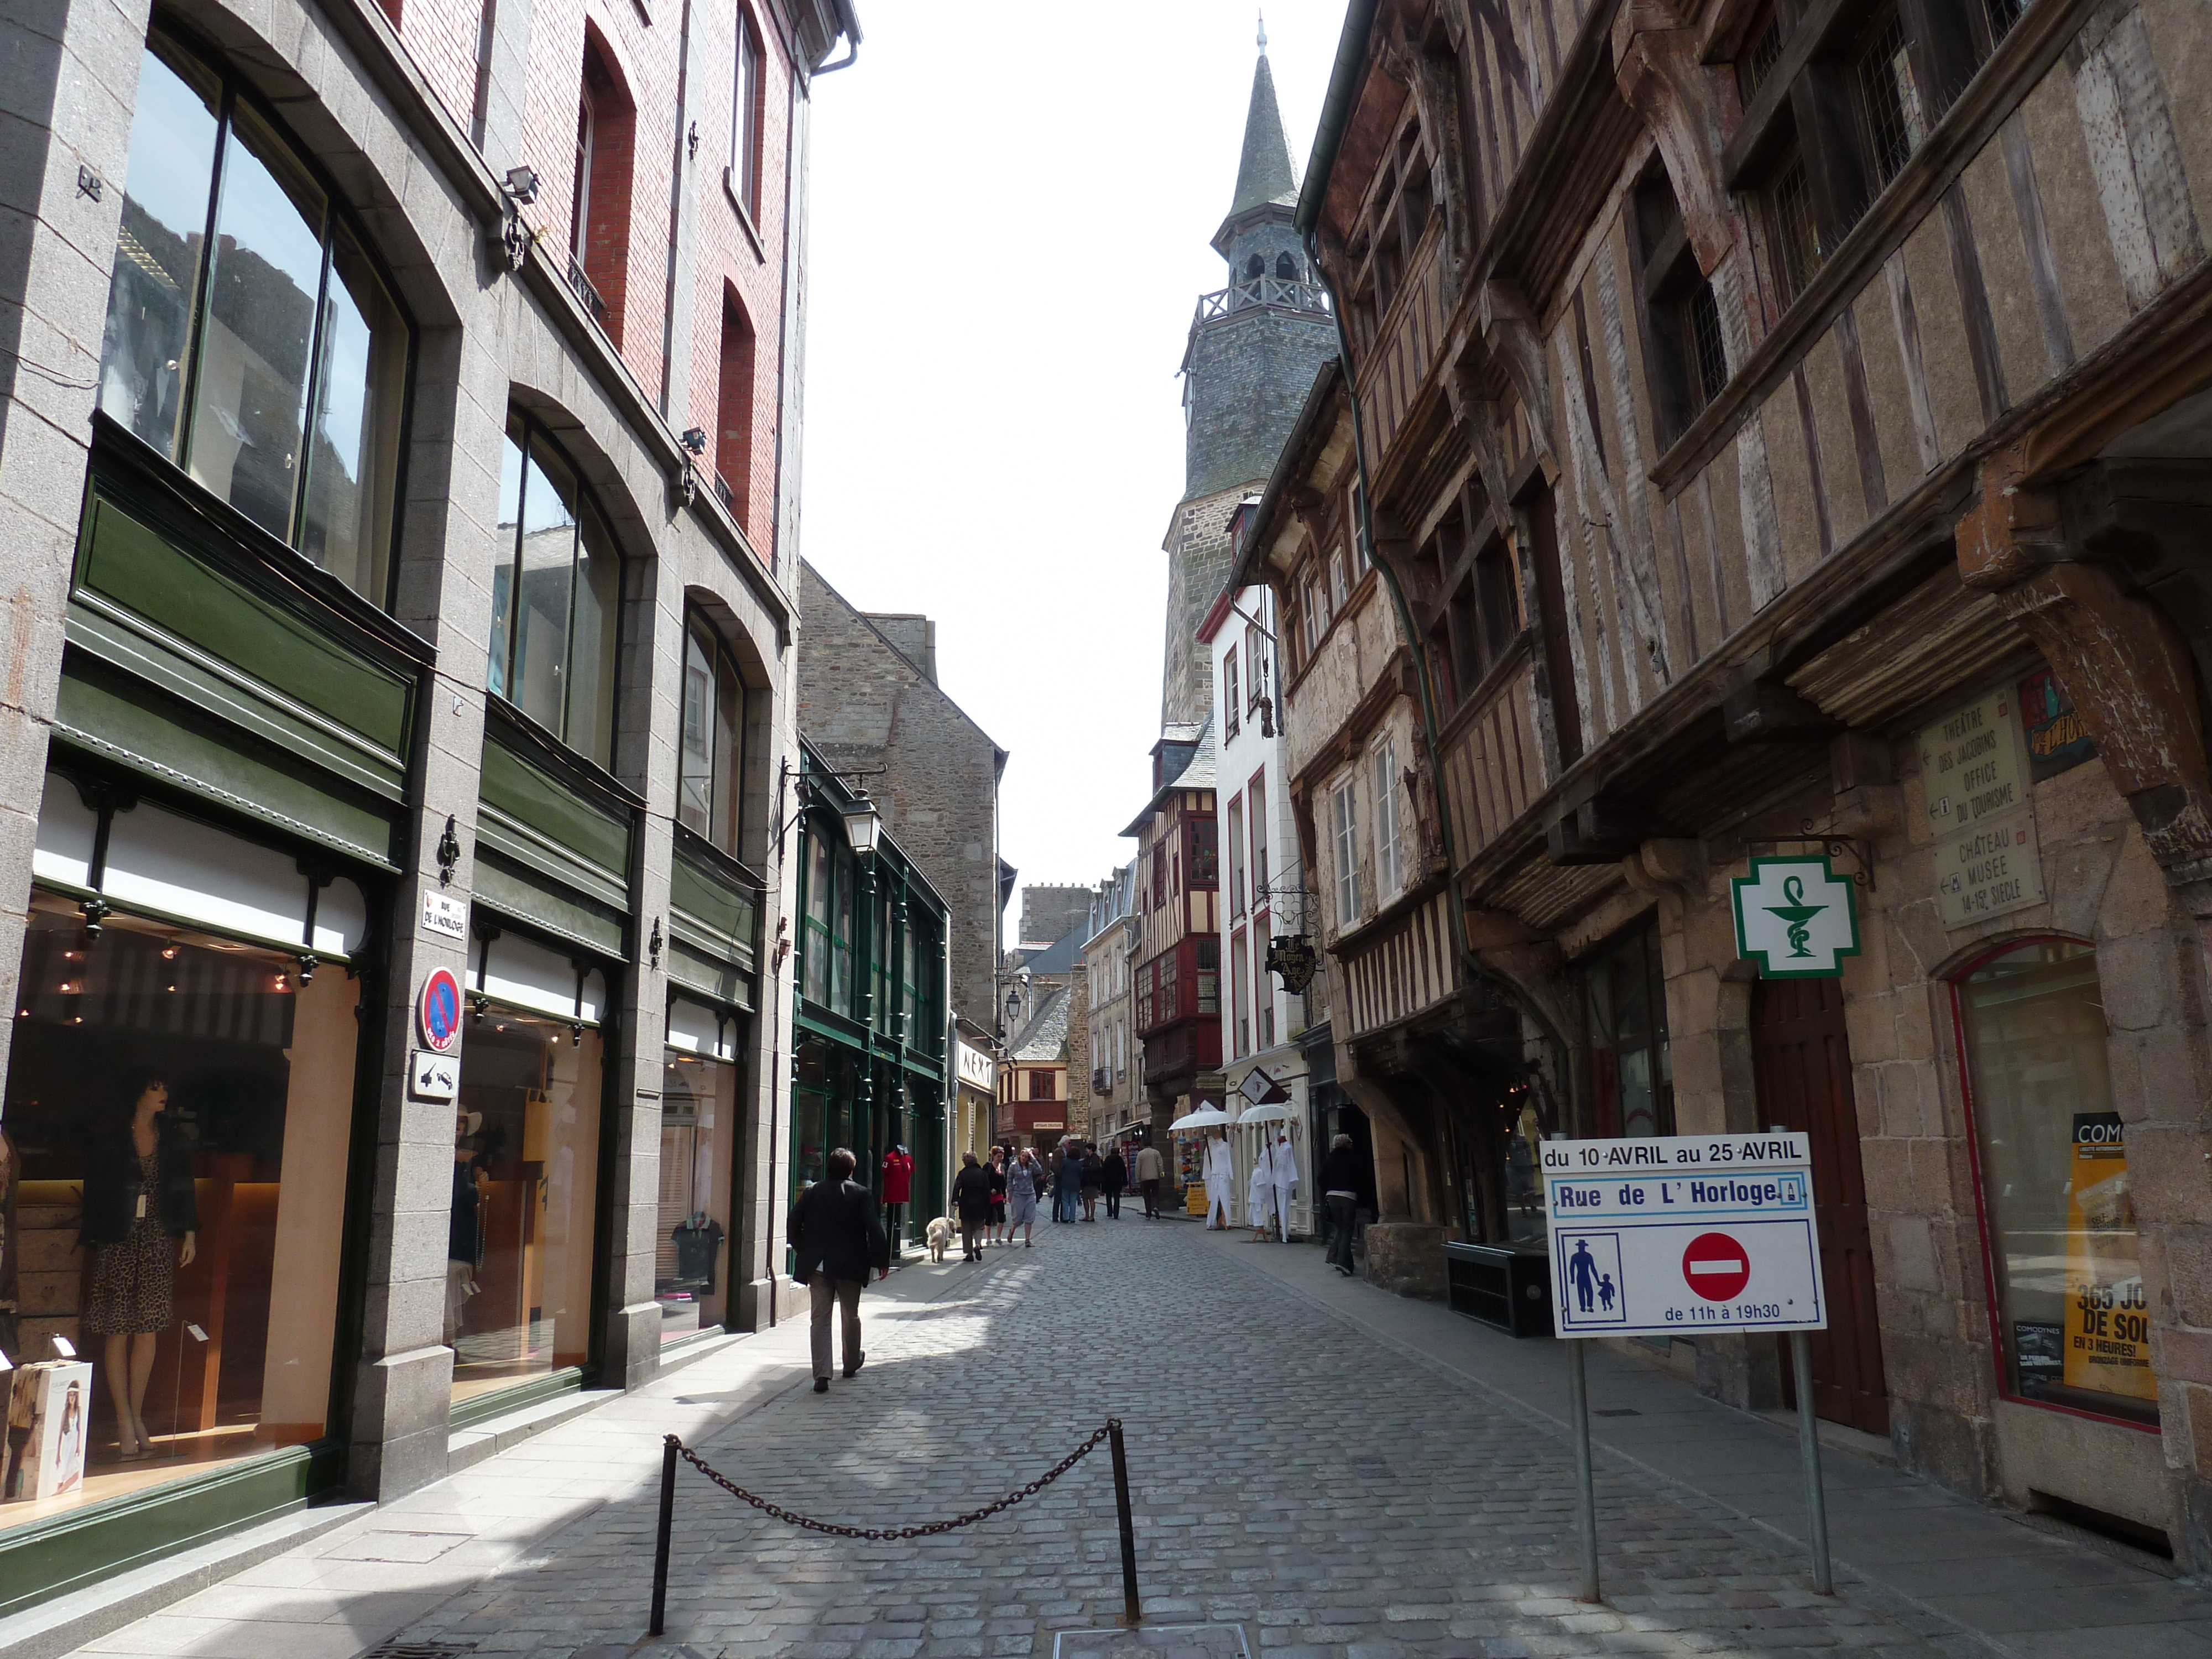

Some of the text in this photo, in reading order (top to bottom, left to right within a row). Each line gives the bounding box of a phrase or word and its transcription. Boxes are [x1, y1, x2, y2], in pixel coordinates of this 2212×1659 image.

[1938, 729, 1997, 773] DES JACOBINS
[1963, 760, 1997, 791] OFFICE
[1957, 803, 1969, 822] DU
[1970, 782, 2013, 819] TOURISME
[1959, 827, 2009, 863] CHÂTEAU
[425, 911, 432, 923] DE
[1271, 950, 1304, 966] Moyen
[1281, 962, 1305, 978] Age
[964, 1050, 993, 1083] NEXT
[1545, 1141, 1802, 1167] du 10 AVRIL au 25 AVRIL
[1559, 1180, 1777, 1207] Rue de L' Horloge
[2077, 1284, 2114, 1310] 365
[1665, 1304, 1780, 1321] de 11h à 19h30
[2083, 1309, 2108, 1337] DE
[2016, 1325, 2060, 1334] COMODYNES
[2074, 1336, 2136, 1358] EN 3 HEURES!
[2089, 1355, 2150, 1368] BRONZAGE UNIFORME
